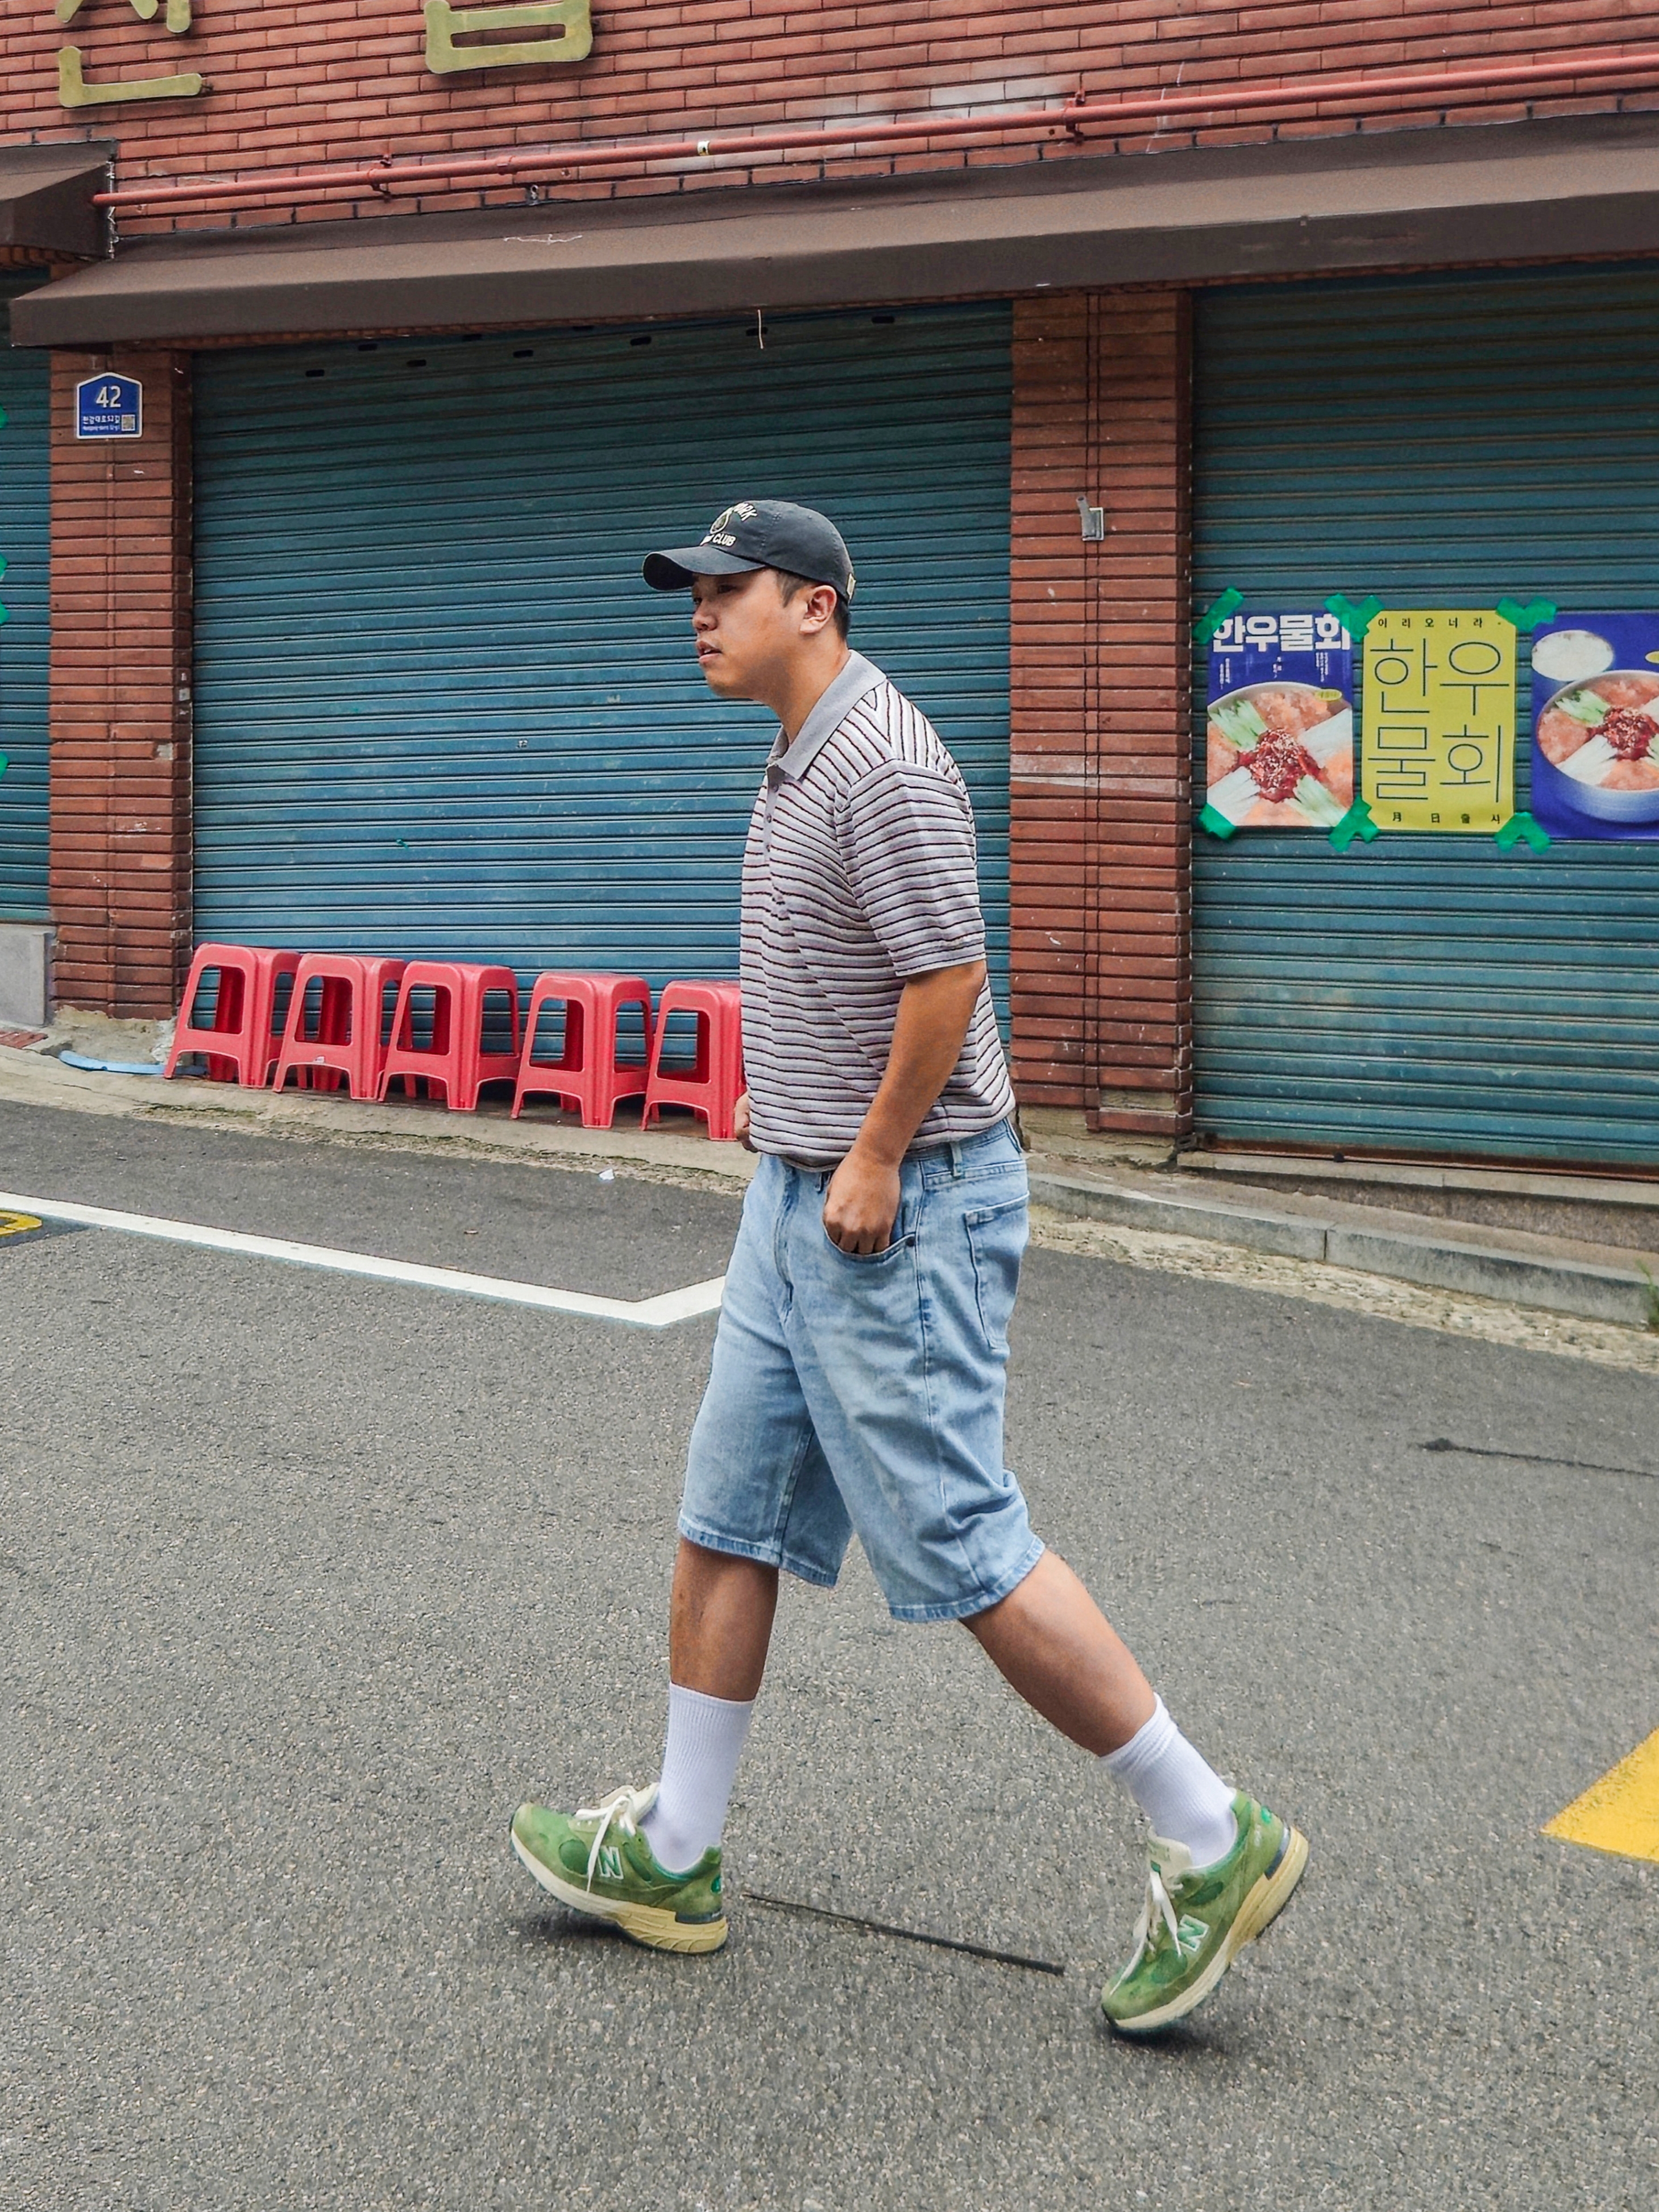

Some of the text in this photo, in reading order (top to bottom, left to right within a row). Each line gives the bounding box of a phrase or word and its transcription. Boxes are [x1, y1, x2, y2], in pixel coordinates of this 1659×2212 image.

[96, 385, 121, 408] 42
[712, 533, 736, 546] CLUB
[1370, 638, 1509, 716] 한우
[1367, 724, 1501, 803] 물회
